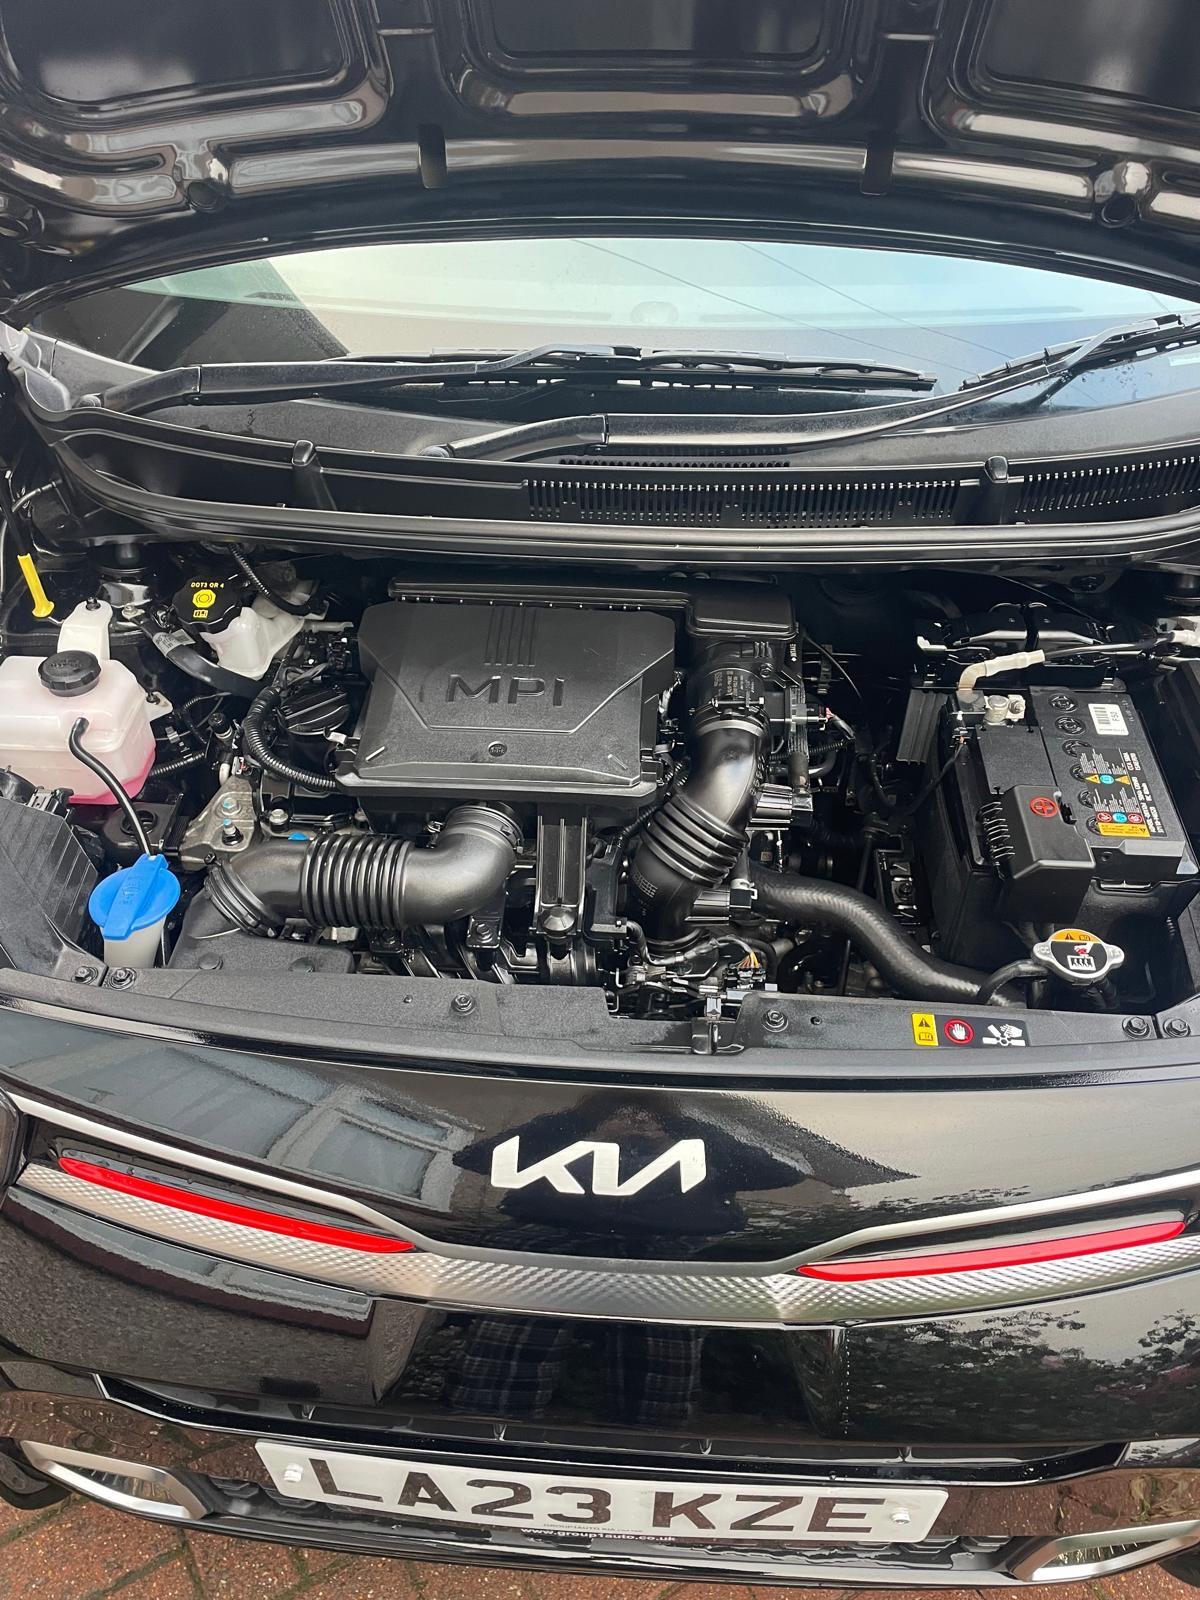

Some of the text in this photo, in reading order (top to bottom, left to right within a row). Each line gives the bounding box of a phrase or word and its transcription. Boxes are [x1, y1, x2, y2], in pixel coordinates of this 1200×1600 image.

[446, 673, 565, 707] MPI
[491, 1135, 707, 1197] KIA
[308, 1457, 887, 1533] LA23 KZE
[520, 1527, 676, 1542] www.group1auto.co.uk
